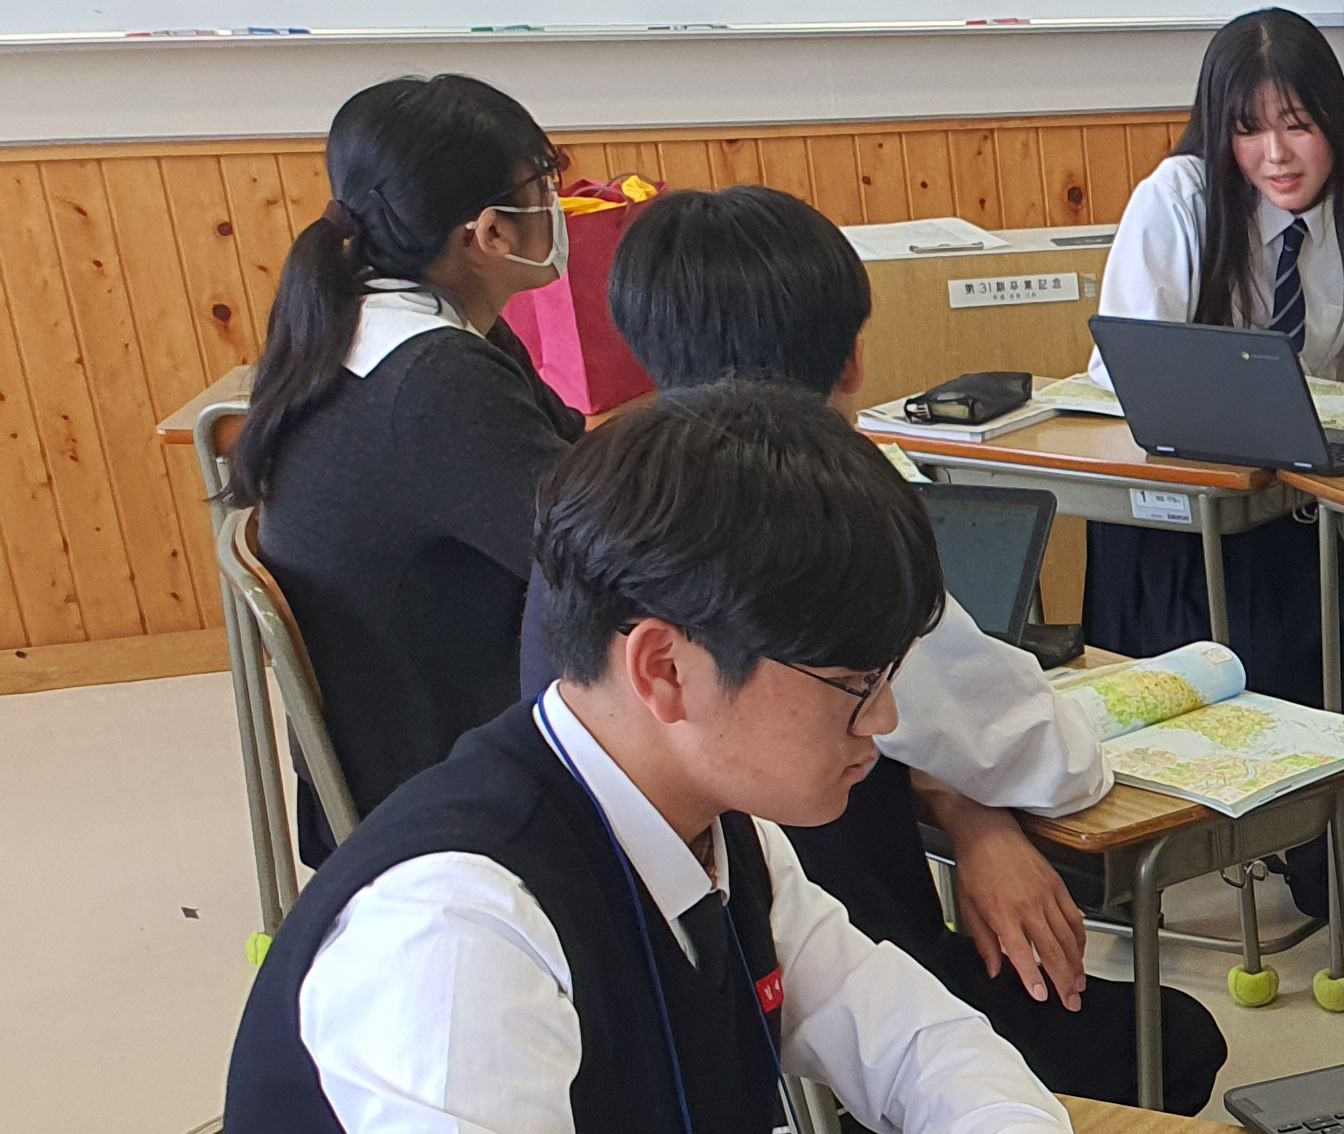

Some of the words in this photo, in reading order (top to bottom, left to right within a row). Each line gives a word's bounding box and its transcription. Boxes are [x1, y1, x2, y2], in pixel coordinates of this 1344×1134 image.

[964, 277, 1062, 295] 第31期卒業記念
